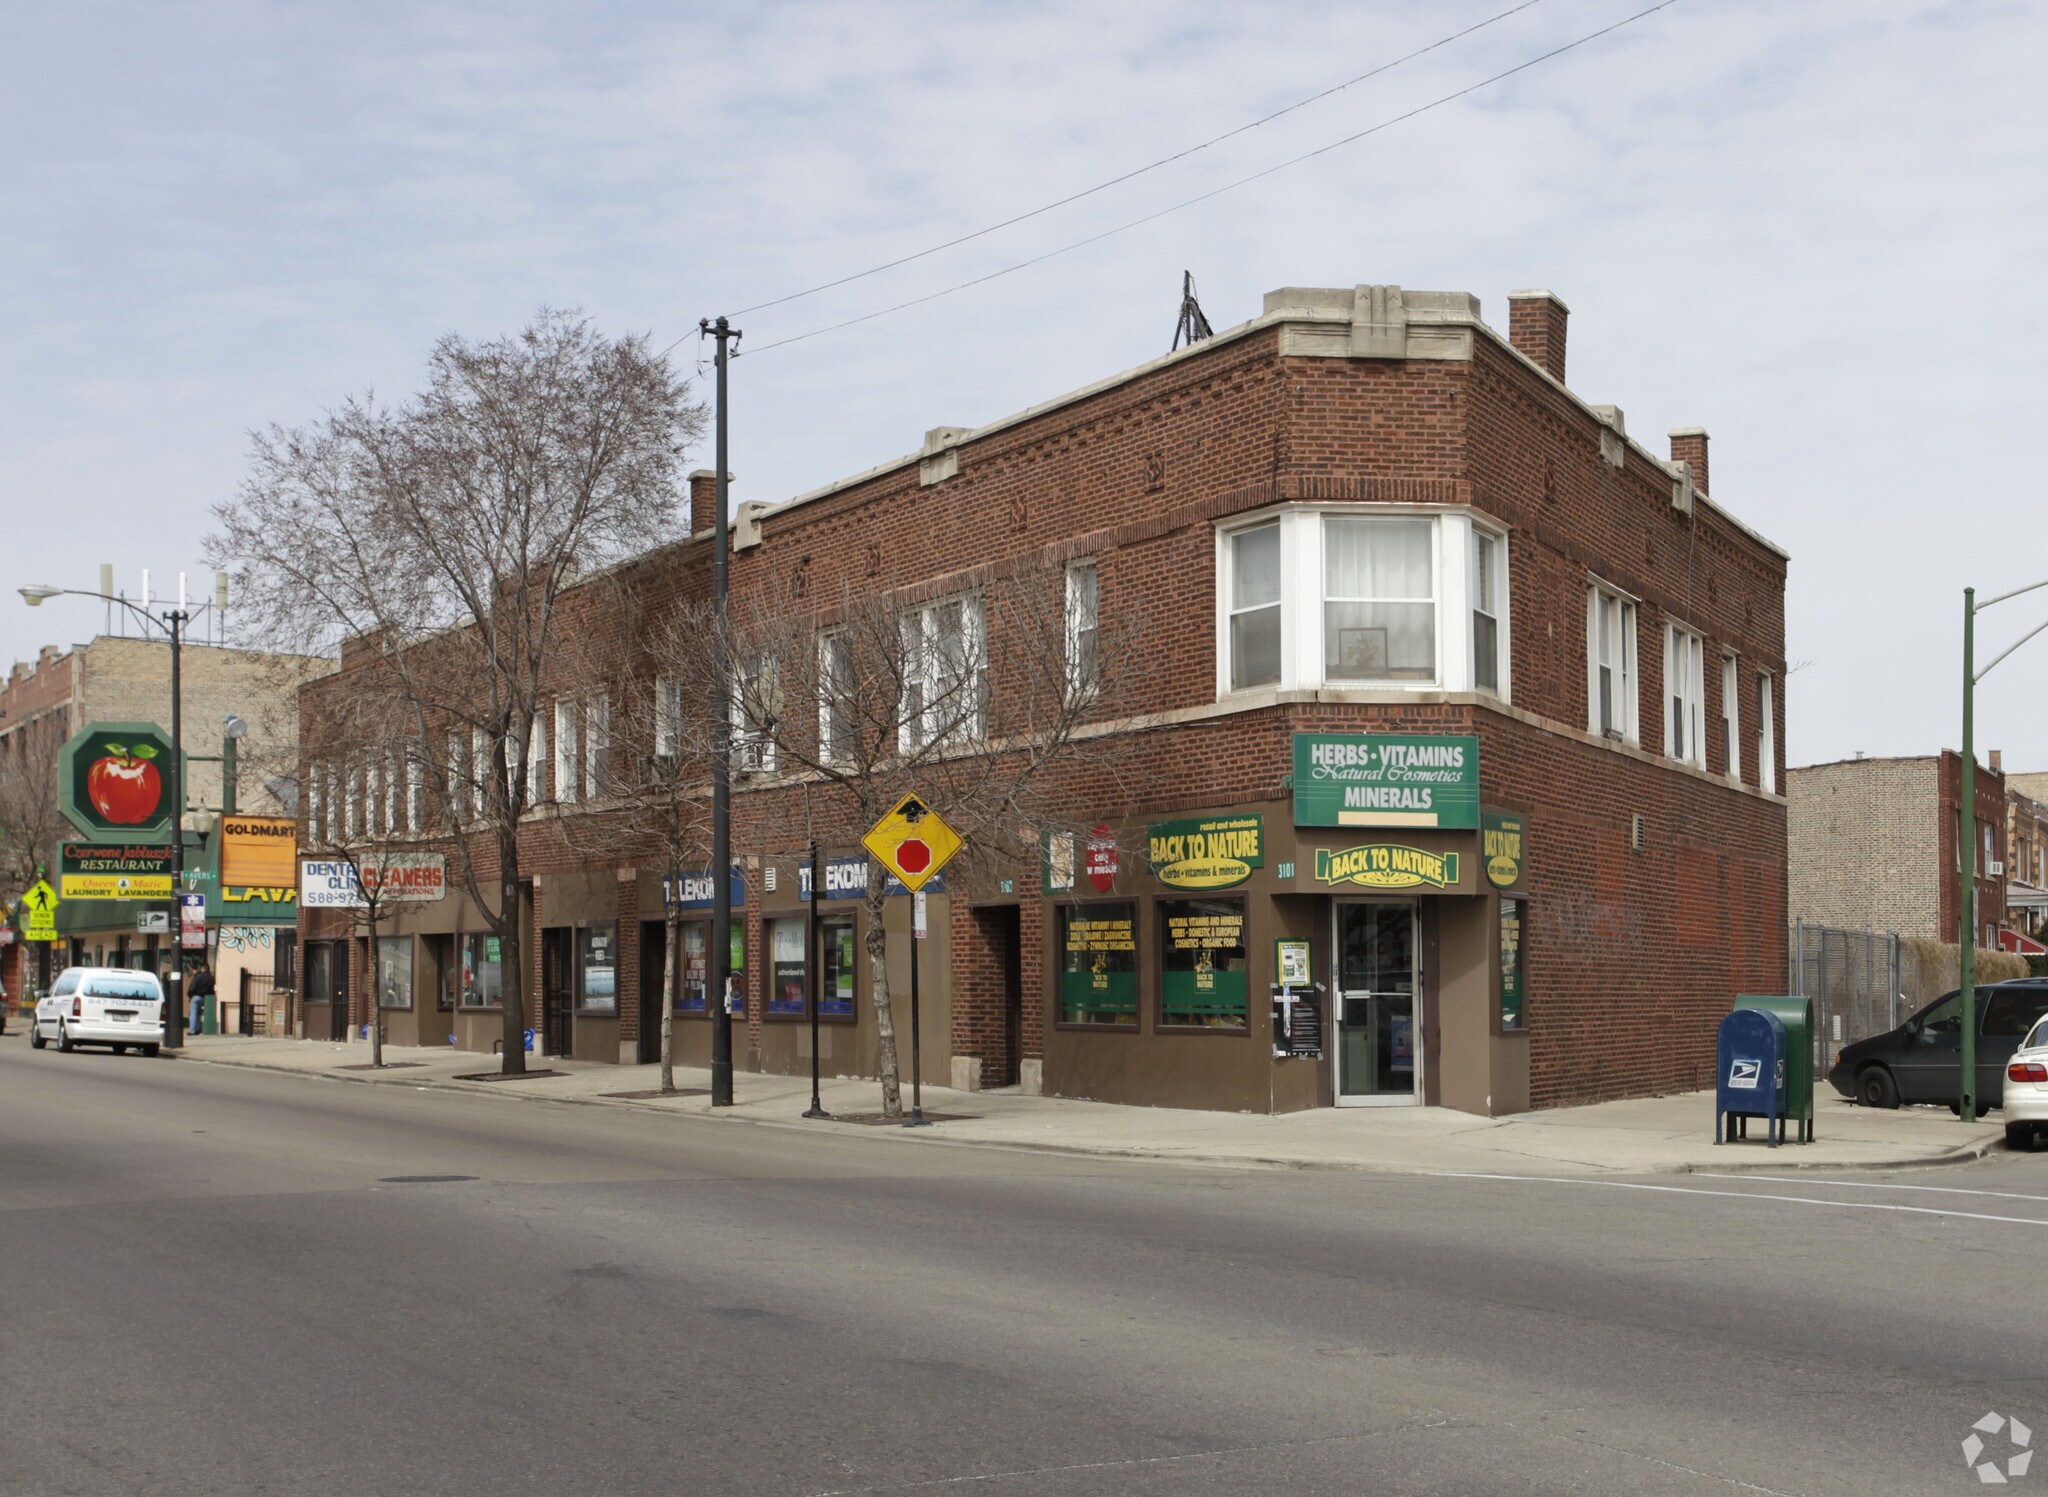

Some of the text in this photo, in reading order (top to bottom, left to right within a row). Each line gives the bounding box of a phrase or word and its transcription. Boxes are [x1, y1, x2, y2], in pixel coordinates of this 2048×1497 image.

[1311, 743, 1464, 768] HERBS VITAMINS
[1311, 762, 1463, 783] Natural Cosmetics
[1344, 786, 1432, 809] MINERALS
[225, 823, 296, 837] GOLDMART
[1200, 818, 1258, 831] retail and wholesale
[1150, 829, 1259, 863] BACK TO NATURE
[80, 859, 164, 871] RESTAURANT
[306, 863, 357, 876] DENTA
[1162, 864, 1246, 880] herbs vitamins & minerals
[1277, 862, 1295, 879] 3101
[1331, 847, 1443, 883] BACK TO NATURE
[82, 878, 162, 890] Queen Matic
[328, 876, 358, 890] CLIN
[362, 866, 443, 887] CLEANERS
[799, 862, 868, 893] TEKOM
[66, 888, 113, 897] LAUNDRY
[663, 874, 715, 903] TLEKOM
[29, 931, 55, 939] AHEAD
